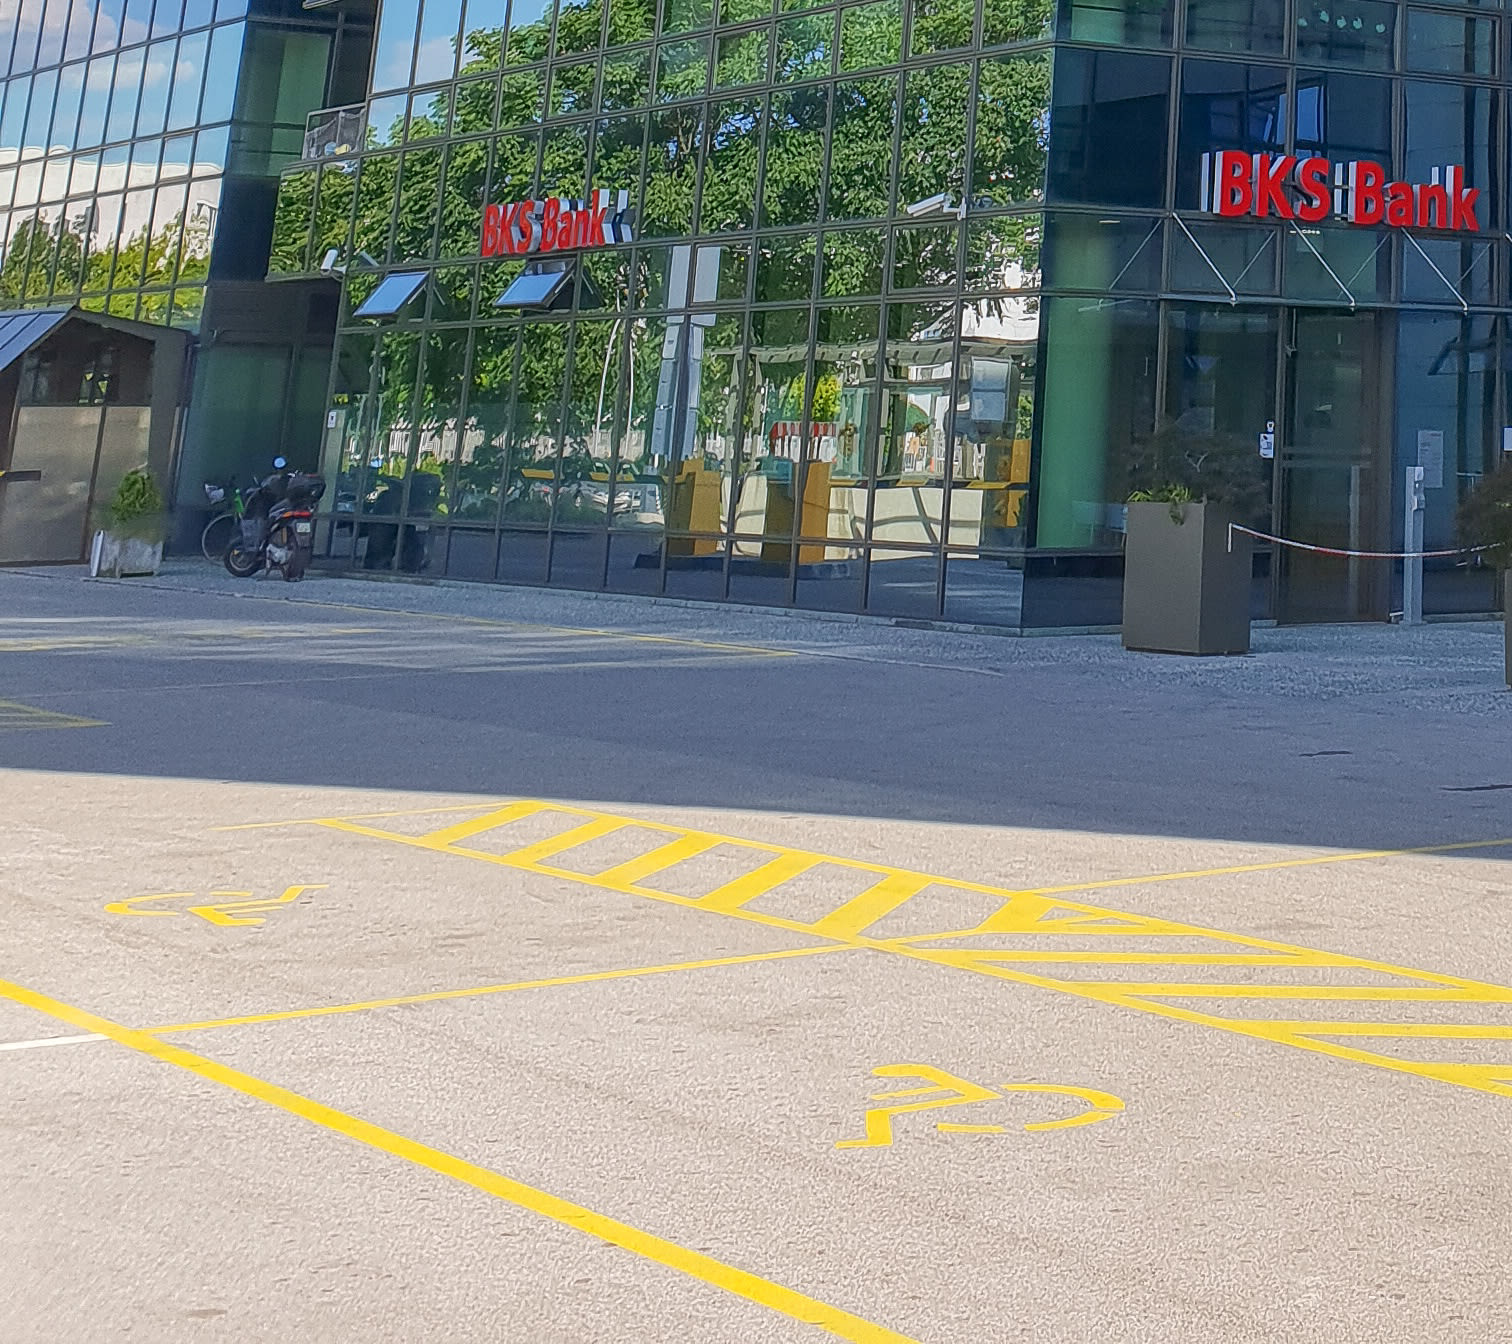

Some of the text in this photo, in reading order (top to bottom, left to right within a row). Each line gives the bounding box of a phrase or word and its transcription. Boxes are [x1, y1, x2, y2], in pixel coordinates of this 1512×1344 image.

[482, 189, 609, 257] BKS Bank
[1214, 150, 1480, 231] BKS Bank
